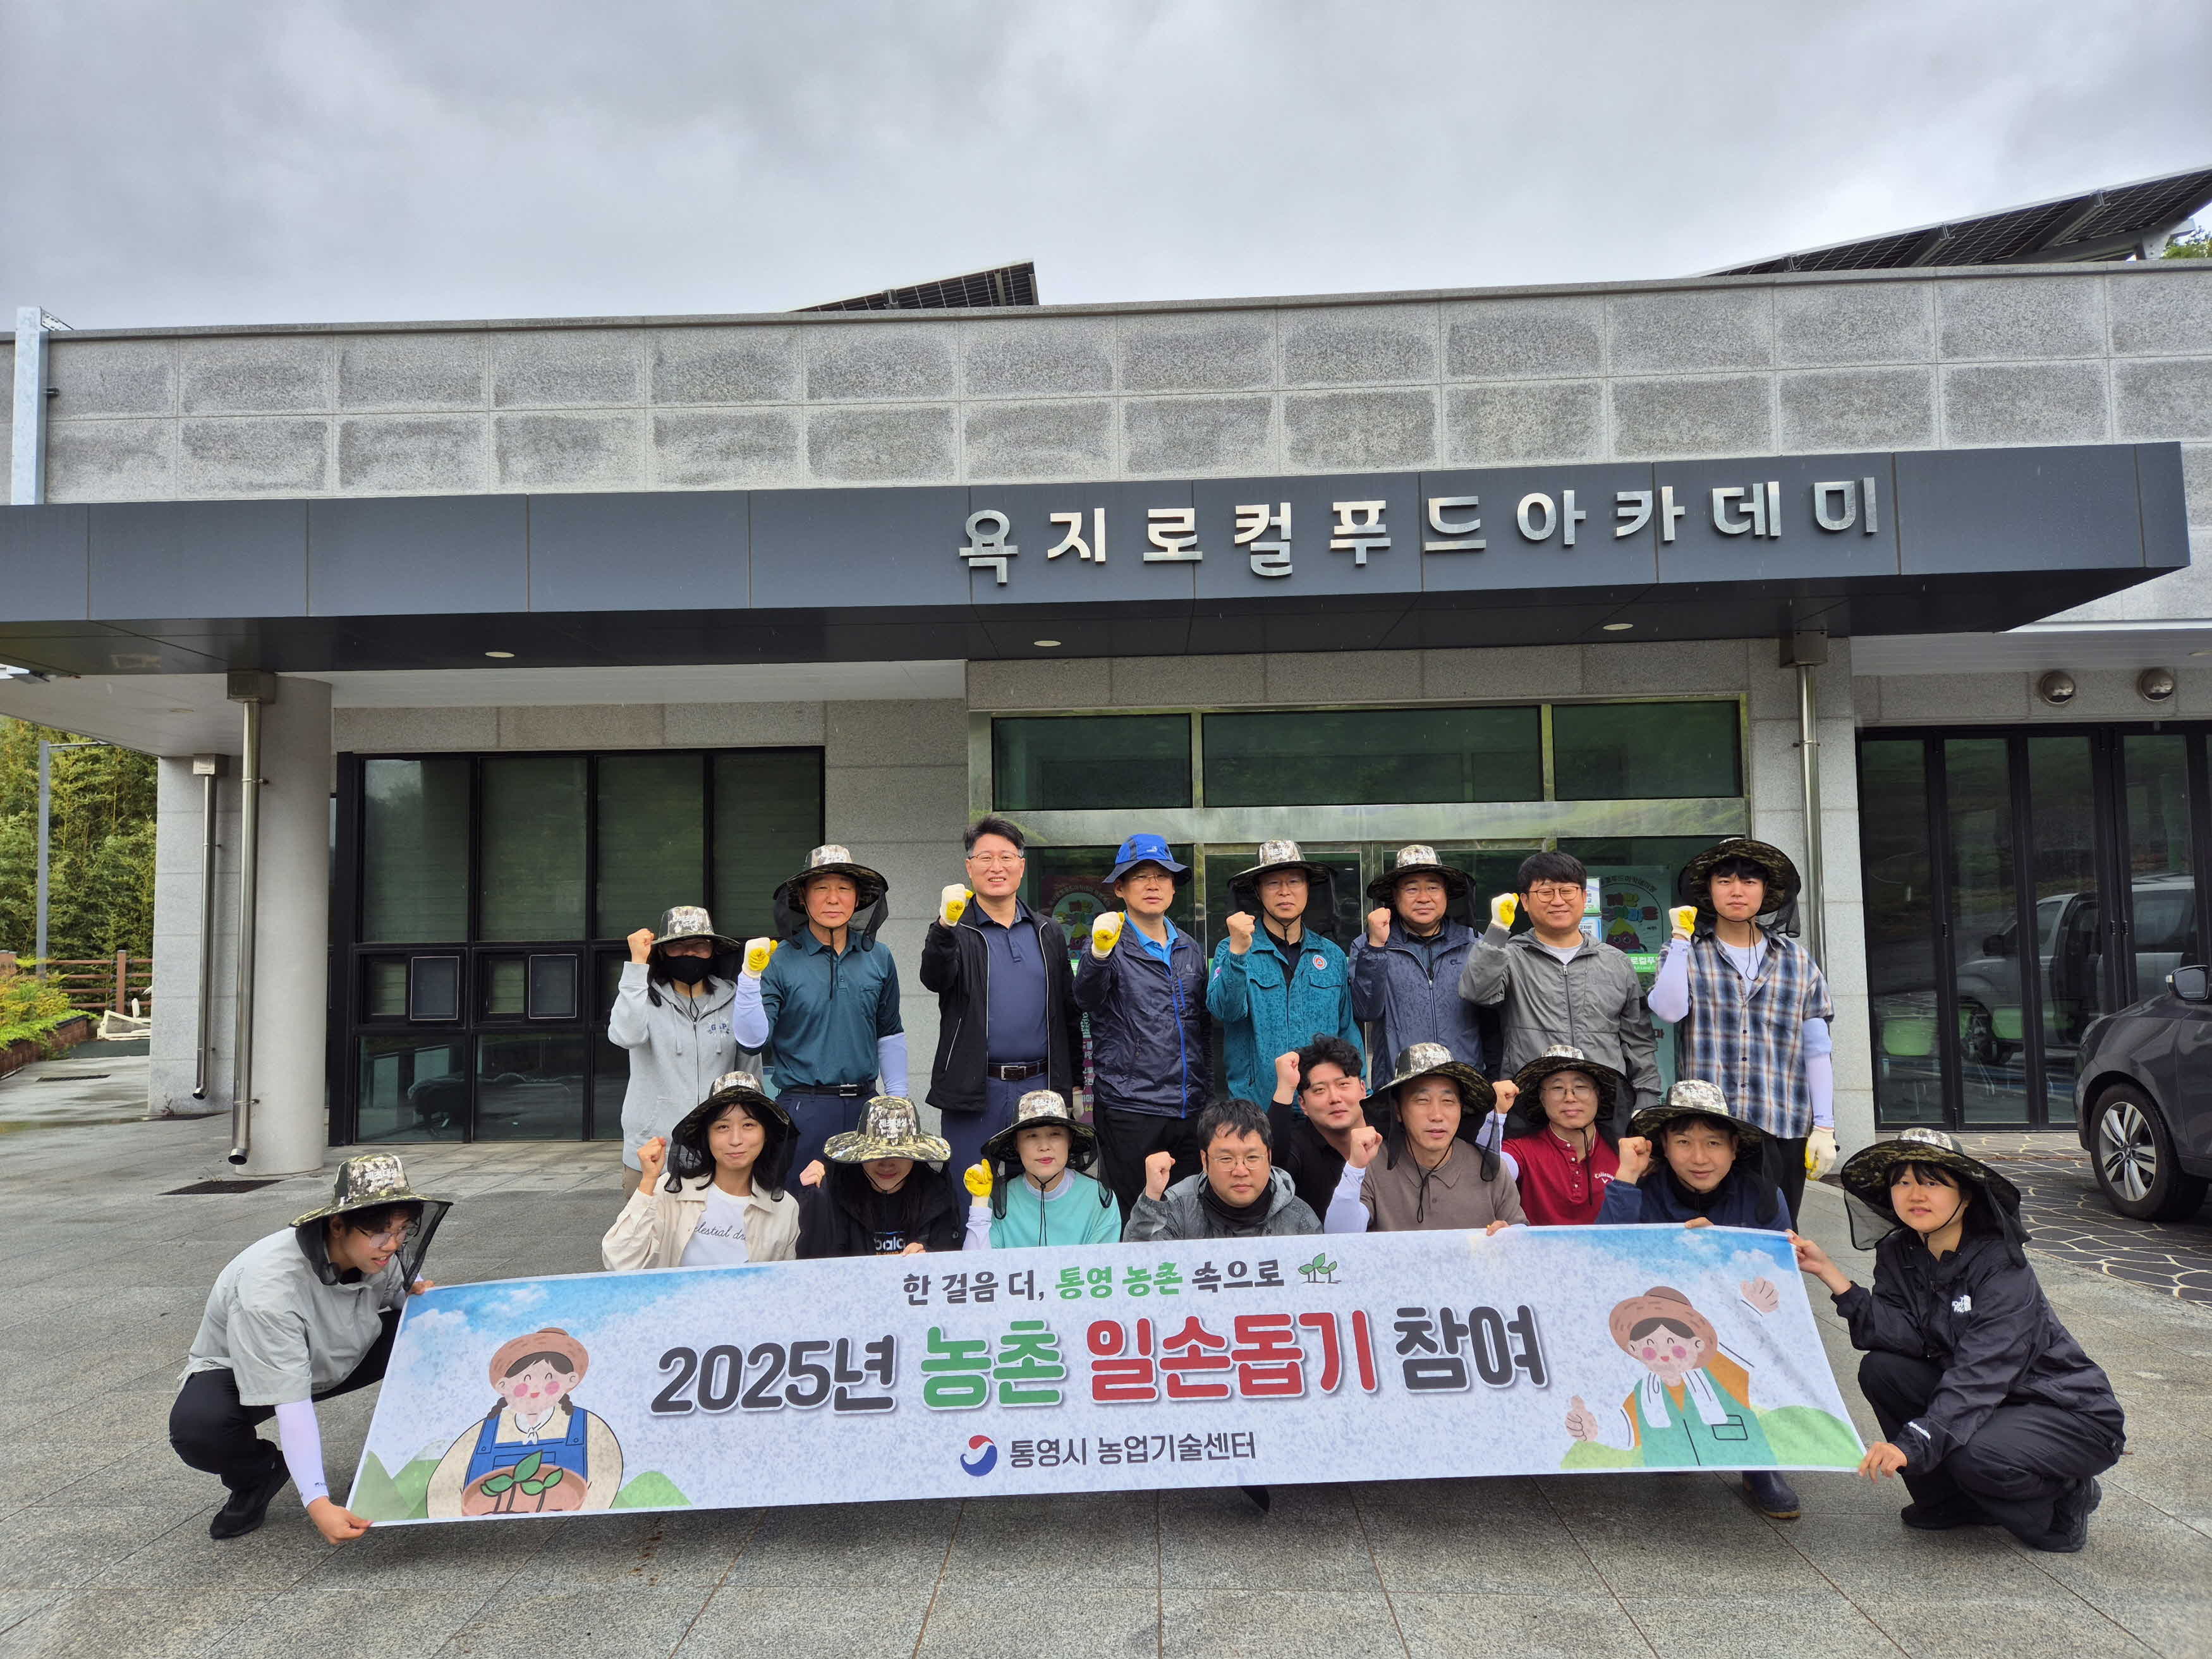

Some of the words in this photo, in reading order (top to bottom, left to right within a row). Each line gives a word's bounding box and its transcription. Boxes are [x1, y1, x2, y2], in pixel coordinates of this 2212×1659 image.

[958, 476, 1878, 584] 욕지로컬푸드아카데미
[904, 1273, 930, 1306] 한
[942, 1270, 999, 1305] 걸음
[1008, 1269, 1045, 1301] 더,
[1055, 1266, 1113, 1300] 통영
[1122, 1262, 1183, 1297] 농촌
[1191, 1260, 1284, 1293] 속으로
[650, 1334, 895, 1414] 2025년
[920, 1320, 1067, 1408] 농촌
[1086, 1310, 1376, 1402] 일손돕기
[1394, 1304, 1547, 1391] 참여
[1010, 1437, 1086, 1468] 통영시
[1098, 1431, 1257, 1465] 농업기술센터
